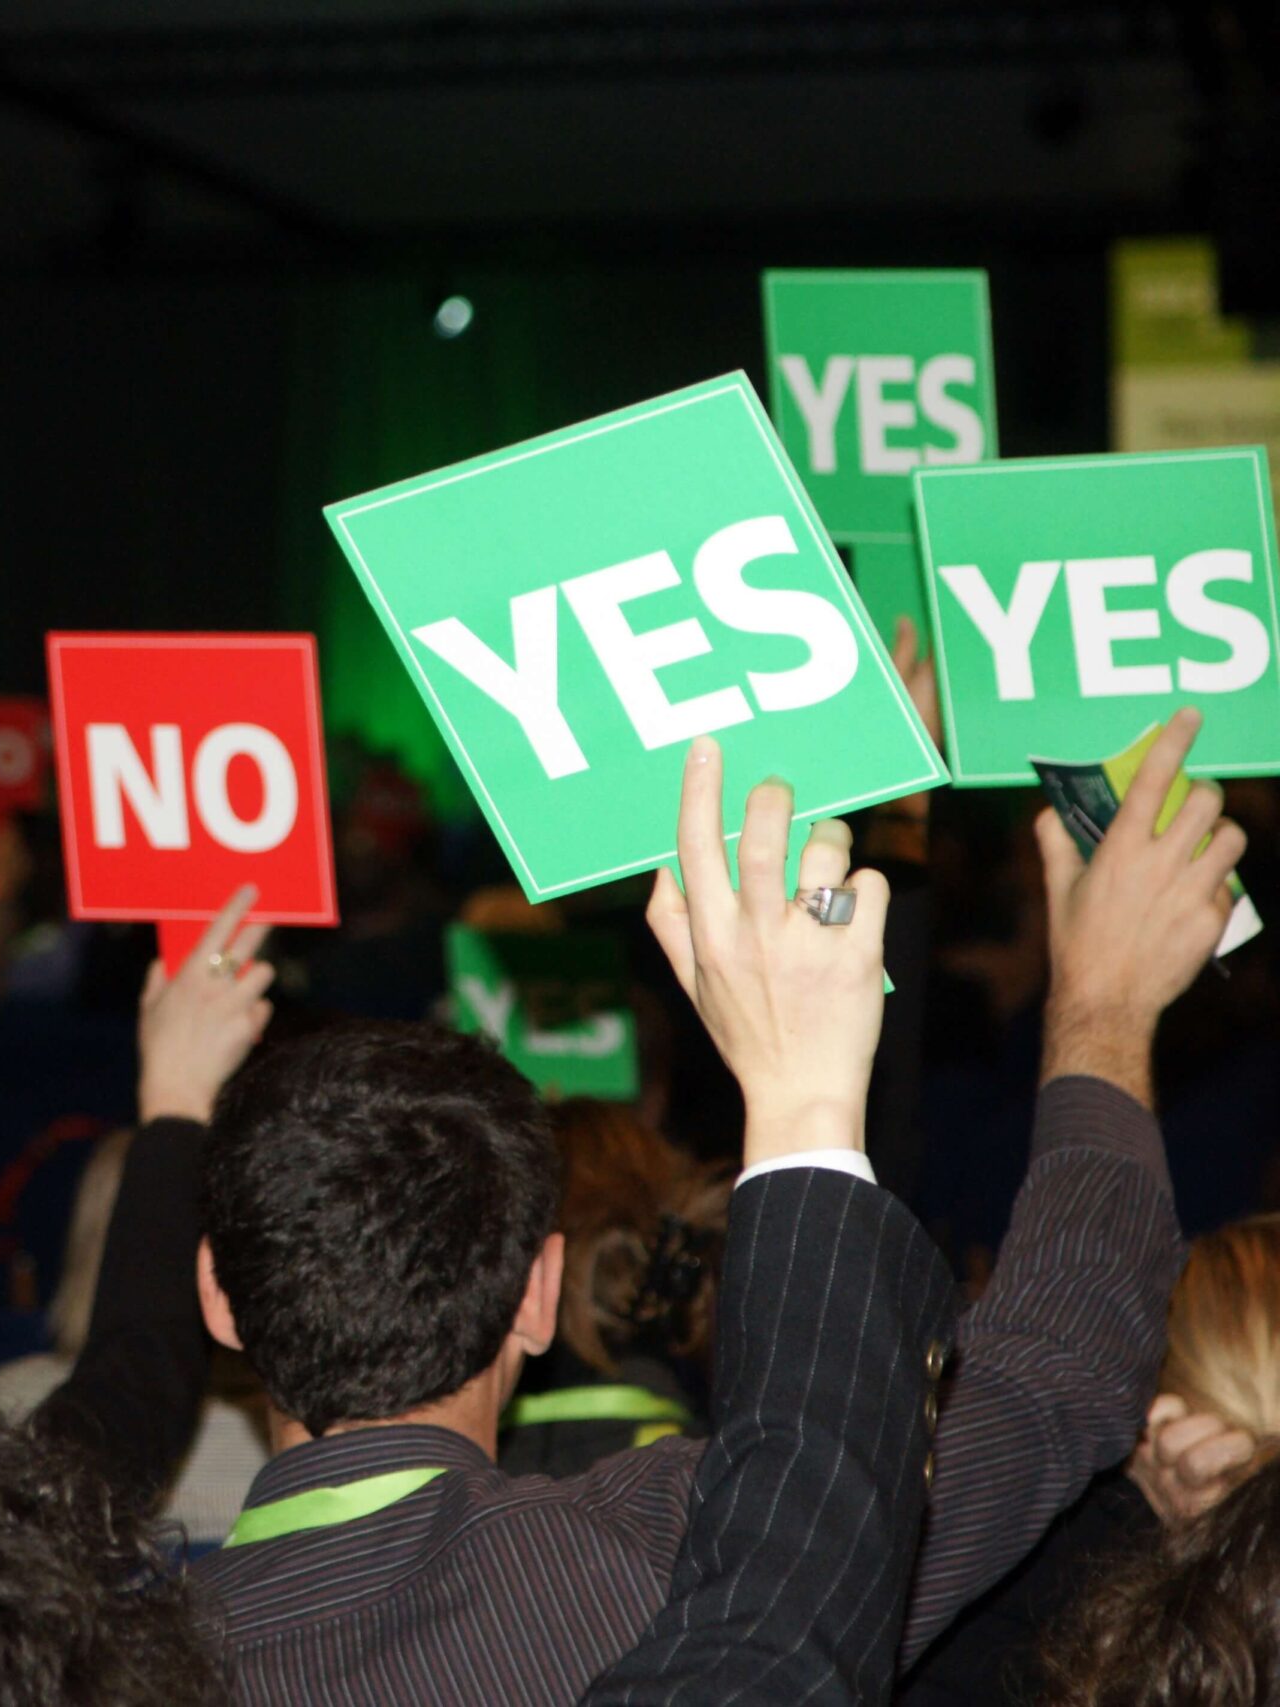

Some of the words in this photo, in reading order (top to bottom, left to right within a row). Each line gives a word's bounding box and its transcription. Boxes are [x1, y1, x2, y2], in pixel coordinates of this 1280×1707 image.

[779, 354, 986, 475] YES
[410, 514, 860, 780] YES
[938, 548, 1272, 702] YES
[85, 722, 299, 853] NO
